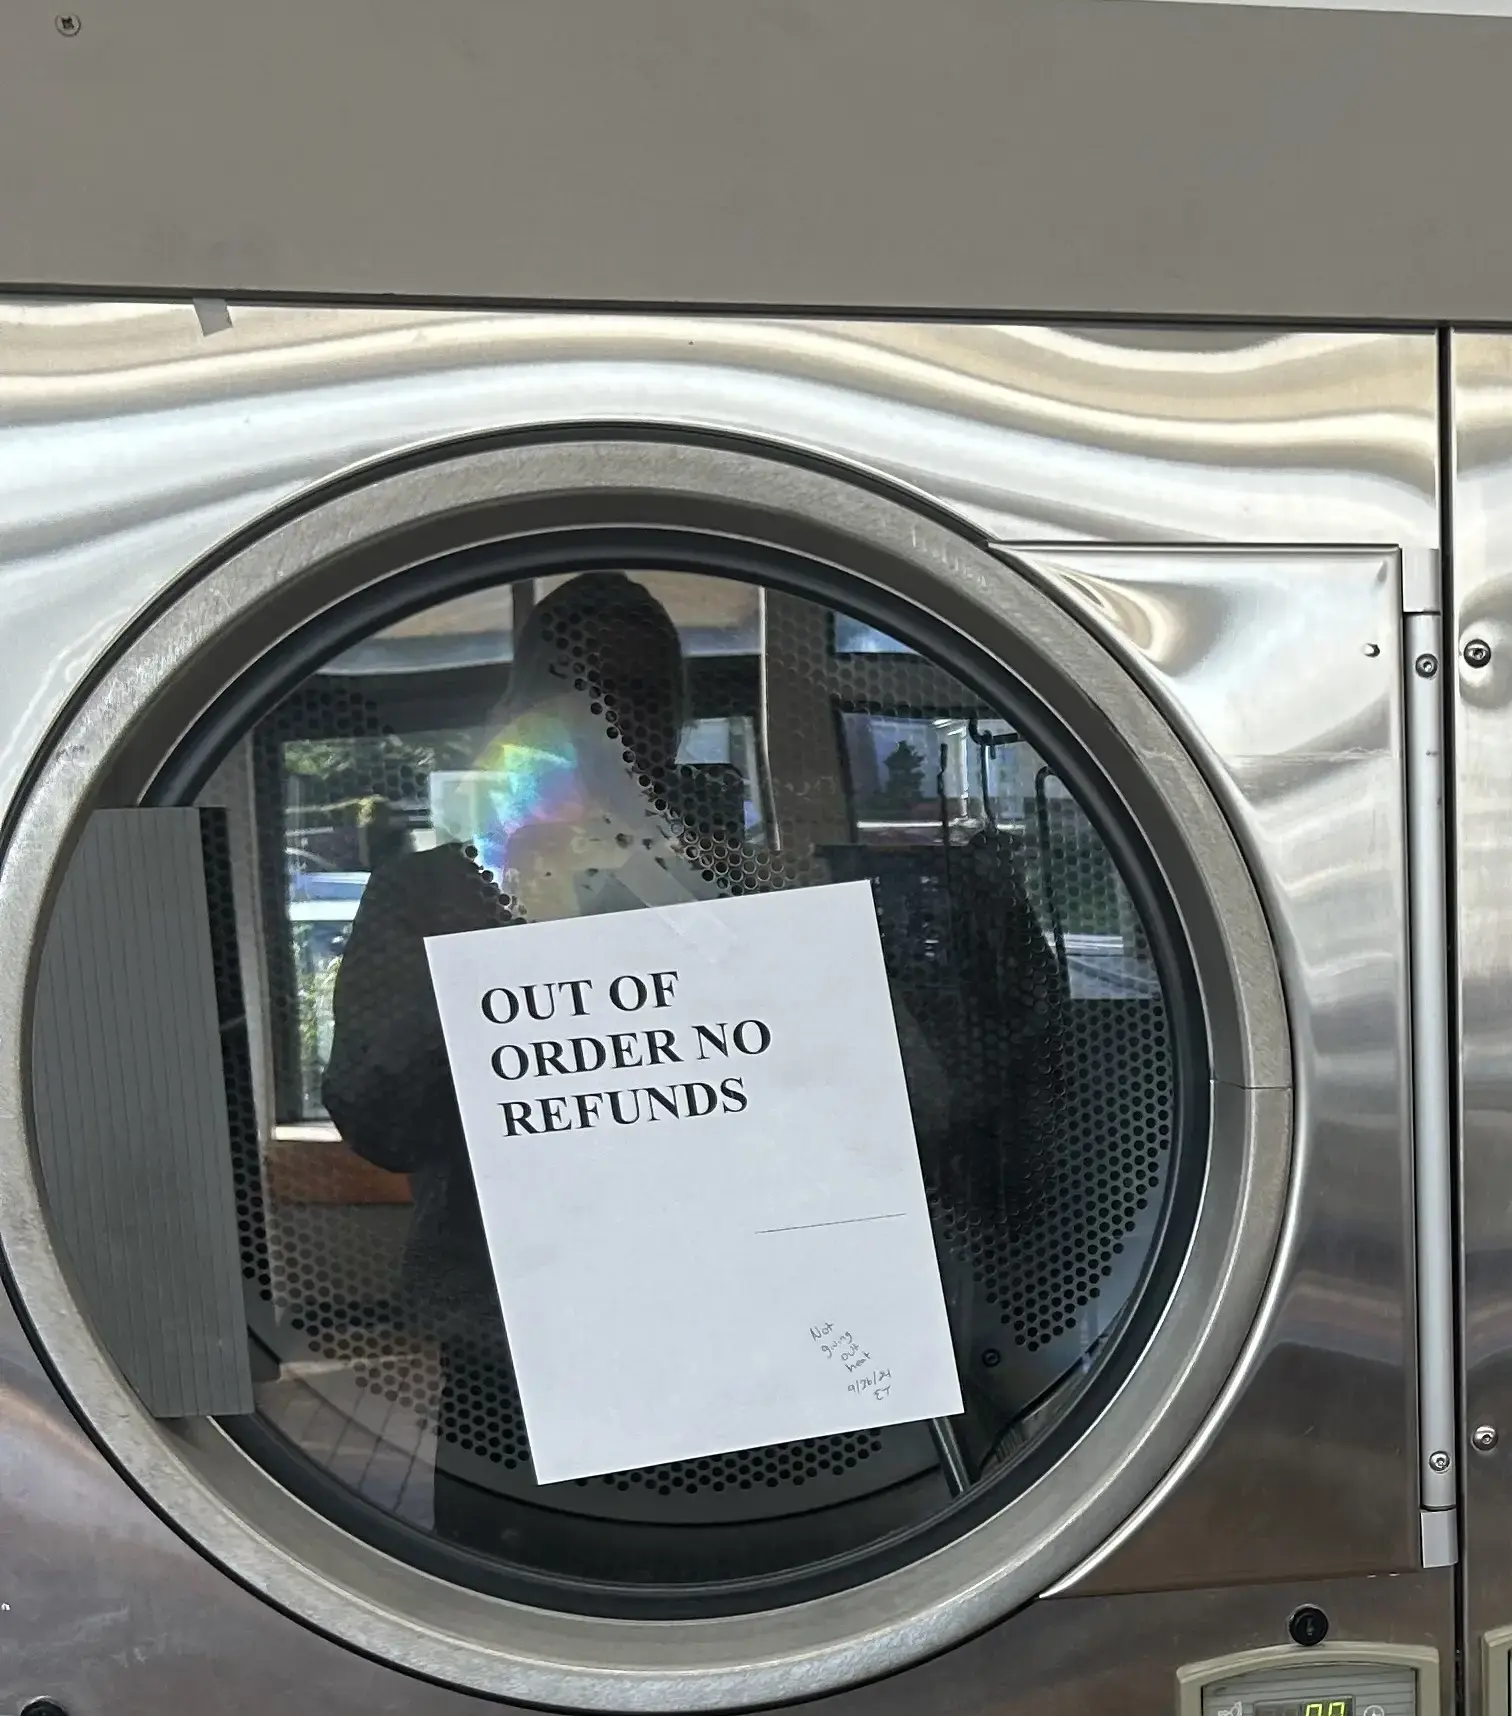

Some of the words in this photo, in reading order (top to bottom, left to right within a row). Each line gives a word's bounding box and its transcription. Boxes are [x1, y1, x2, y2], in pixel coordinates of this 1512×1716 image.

[481, 979, 593, 1025] OUT
[609, 970, 679, 1012] OF
[491, 1029, 685, 1081] ORDER
[691, 1019, 771, 1061] NO
[497, 1077, 748, 1137] REFUNDS
